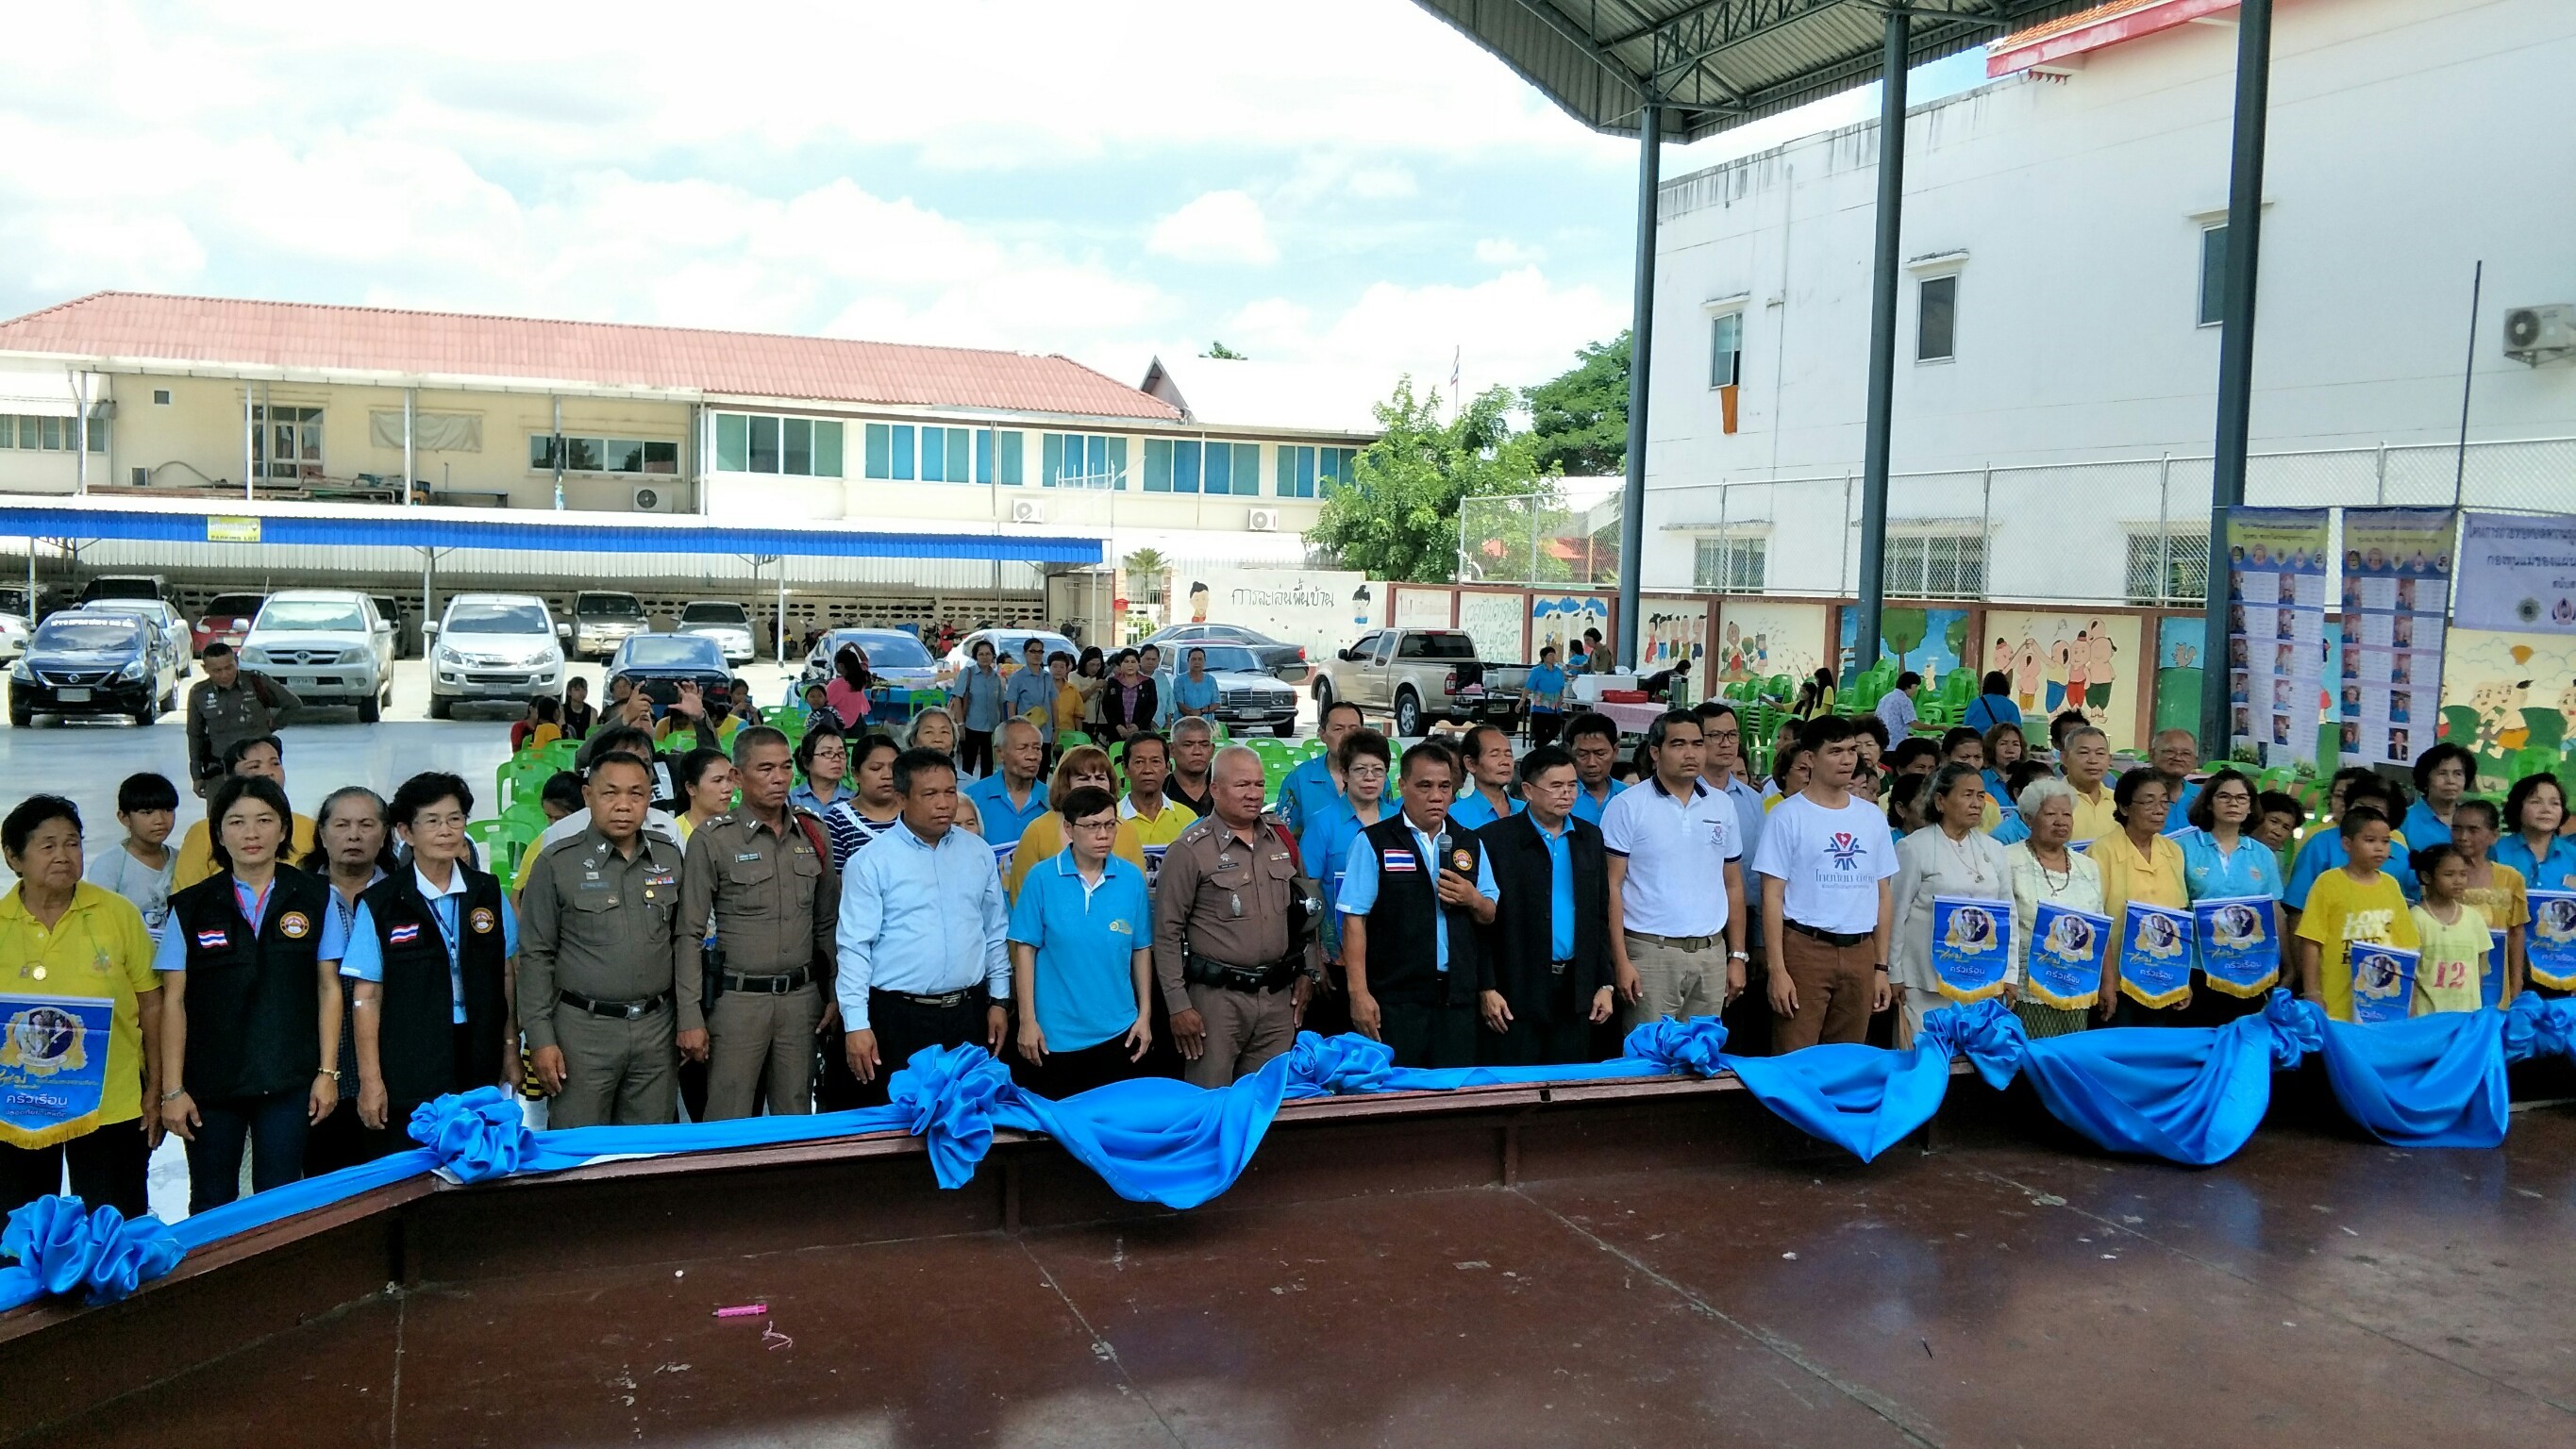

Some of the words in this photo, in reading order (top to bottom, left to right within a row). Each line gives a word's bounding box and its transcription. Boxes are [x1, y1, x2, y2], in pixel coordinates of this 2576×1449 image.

[1231, 577, 1334, 607] การละเล่นพื้นบ้าน
[2433, 960, 2466, 990] 12
[6, 1091, 68, 1107] ครัวเรือน
